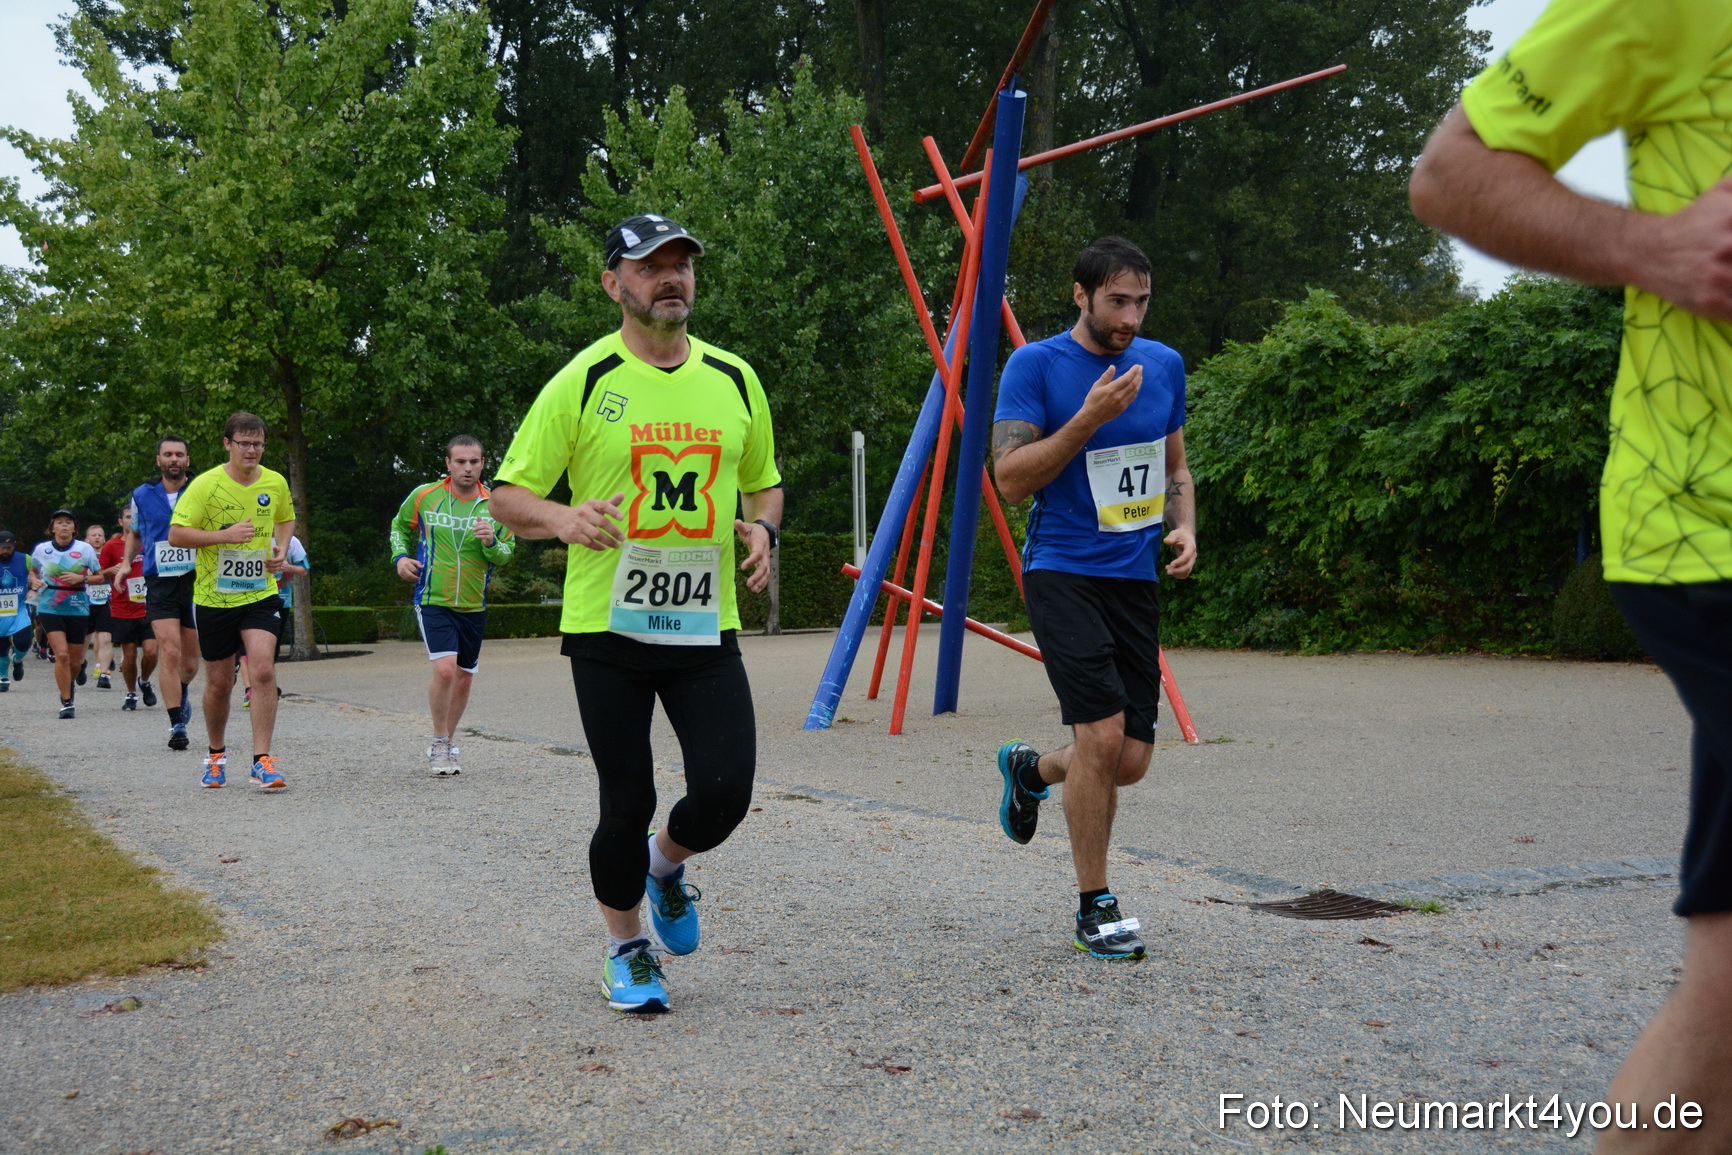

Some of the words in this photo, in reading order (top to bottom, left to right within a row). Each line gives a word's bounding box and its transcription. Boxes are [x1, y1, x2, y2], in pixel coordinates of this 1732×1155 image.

[629, 421, 724, 445] Müller
[1124, 443, 1162, 457] BOCK
[1118, 463, 1150, 498] 47
[651, 471, 699, 512] M
[1123, 504, 1151, 520] Peter
[160, 548, 192, 563] 2281
[628, 554, 662, 564] NeuerMarkt
[667, 550, 714, 563] BOCK
[223, 559, 263, 578] 2889
[230, 581, 255, 589] Philipp
[623, 569, 712, 607] 2804
[648, 615, 682, 631] Mike
